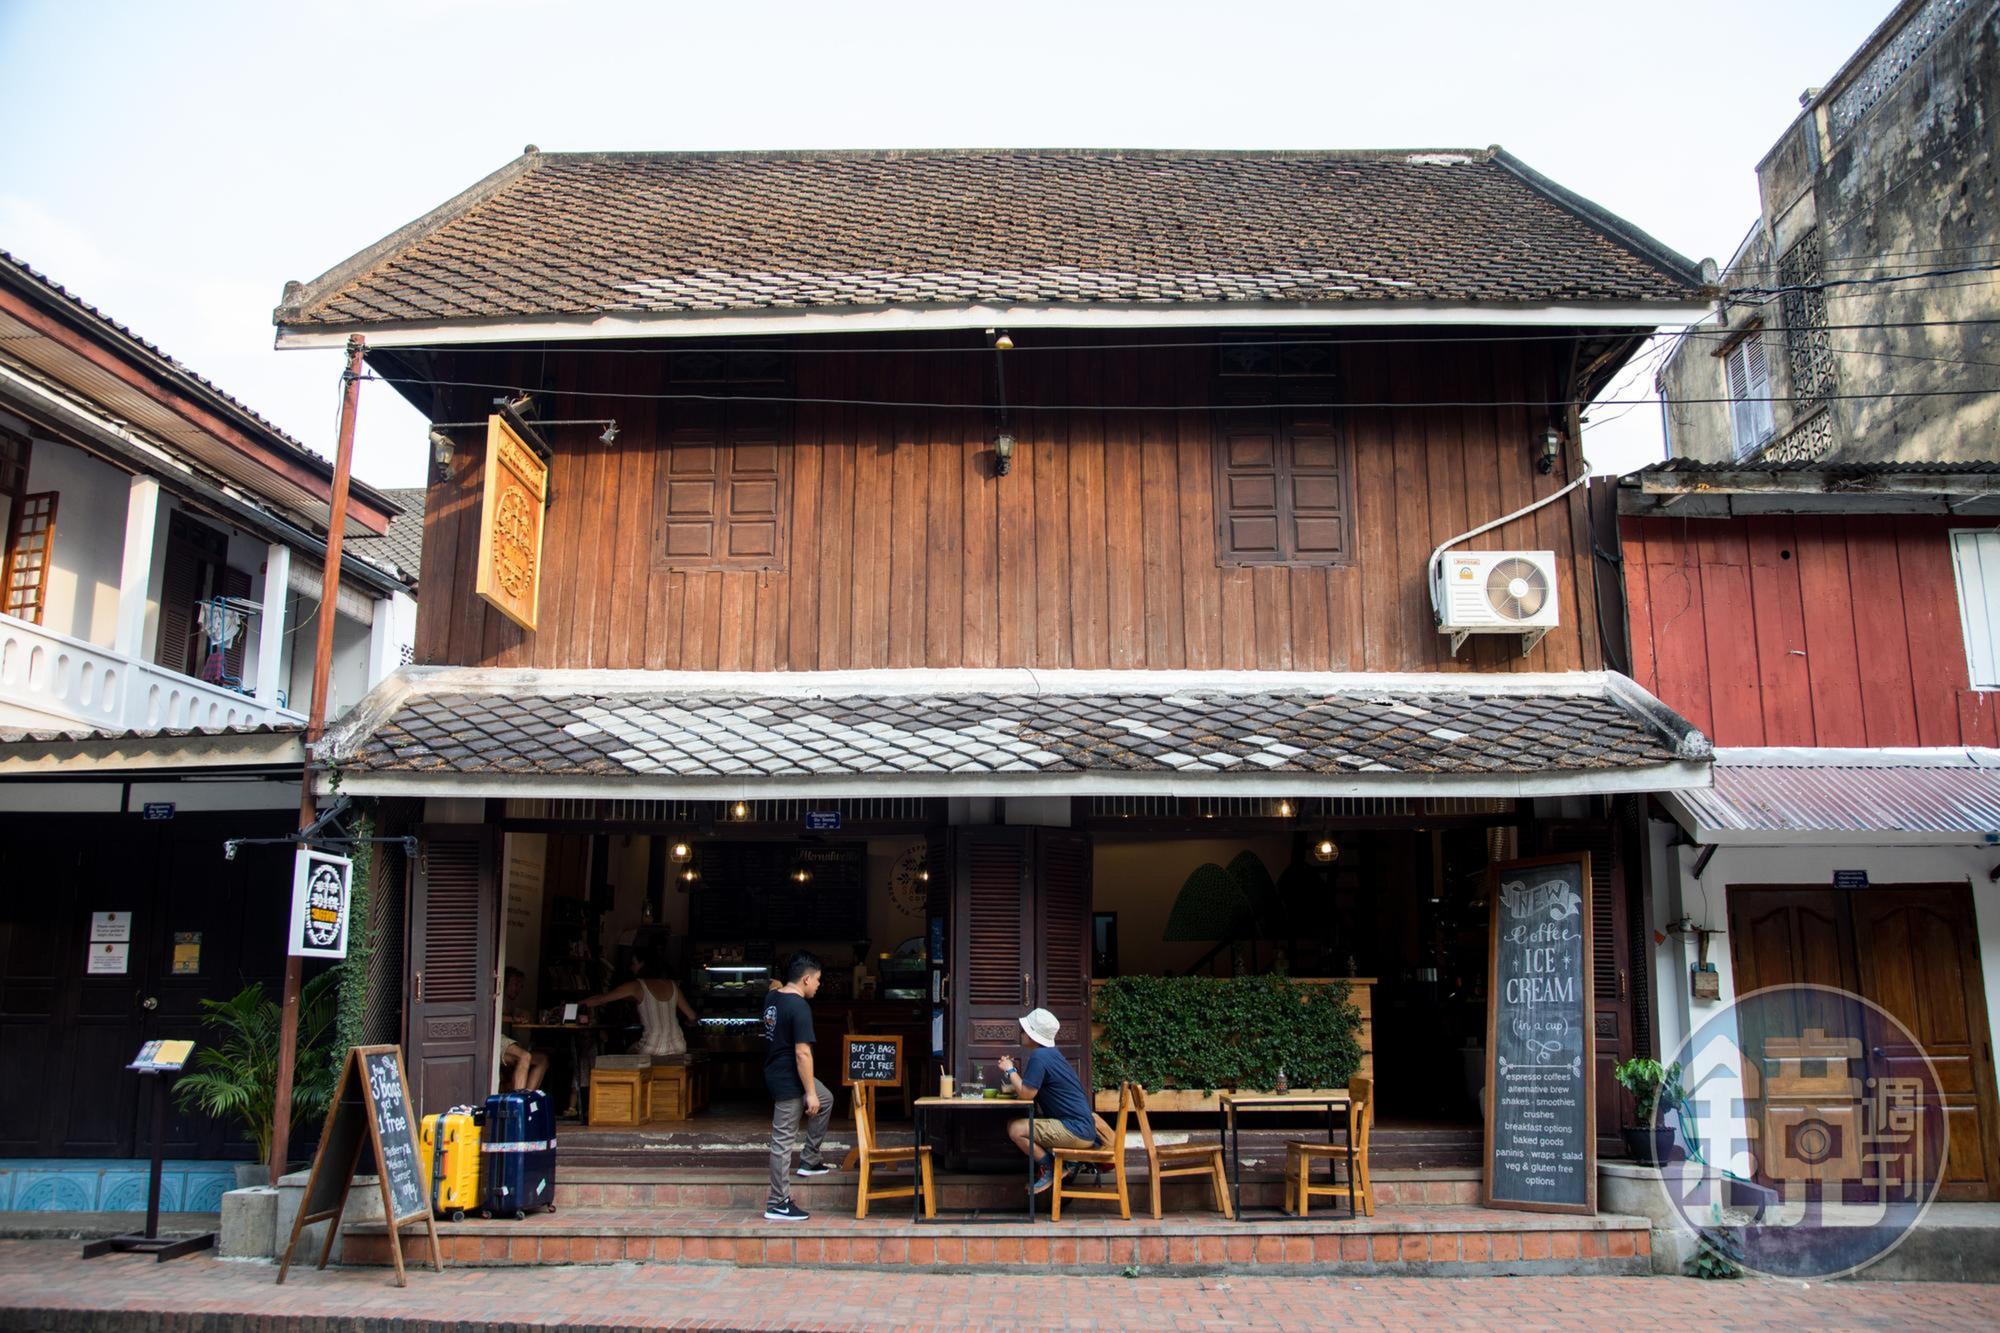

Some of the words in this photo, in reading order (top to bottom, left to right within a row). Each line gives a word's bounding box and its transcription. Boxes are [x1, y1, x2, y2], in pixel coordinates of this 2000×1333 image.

[1517, 882, 1563, 917] NEW
[1504, 922, 1581, 944] Coffee
[1525, 948, 1556, 974] ICE
[1506, 976, 1575, 1010] CREAM
[1534, 1022, 1542, 1030] a
[851, 1043, 867, 1053] BUY
[869, 1043, 876, 1055] 3
[878, 1044, 896, 1055] BAGS
[859, 1053, 886, 1061] COFFEE
[851, 1061, 866, 1069] GET
[869, 1061, 876, 1070] 1
[878, 1061, 895, 1070] FREE
[1506, 1073, 1542, 1081] espresso
[1543, 1073, 1571, 1081] coffees
[370, 1076, 380, 1100] 3
[378, 1075, 402, 1106] bags
[1508, 1085, 1548, 1093] alternative
[1550, 1085, 1569, 1093] brew
[1501, 1097, 1530, 1106] shakes
[1536, 1098, 1575, 1107] smoothies
[381, 1098, 393, 1119] get
[1523, 1110, 1555, 1119] crushes
[378, 1113, 386, 1134] 1
[383, 1112, 407, 1133] free
[1504, 1122, 1542, 1132] breakfast
[1544, 1125, 1573, 1134] options
[1513, 1135, 1538, 1144] baked
[1540, 1138, 1564, 1147] goods
[1496, 1148, 1524, 1158] paninis
[1531, 1151, 1556, 1160] wraps
[1561, 1152, 1583, 1160] salad
[1505, 1162, 1521, 1172] veg
[1522, 1162, 1529, 1171] &
[1531, 1163, 1556, 1173] gluten
[1558, 1164, 1574, 1173] free
[1525, 1177, 1555, 1187] options
